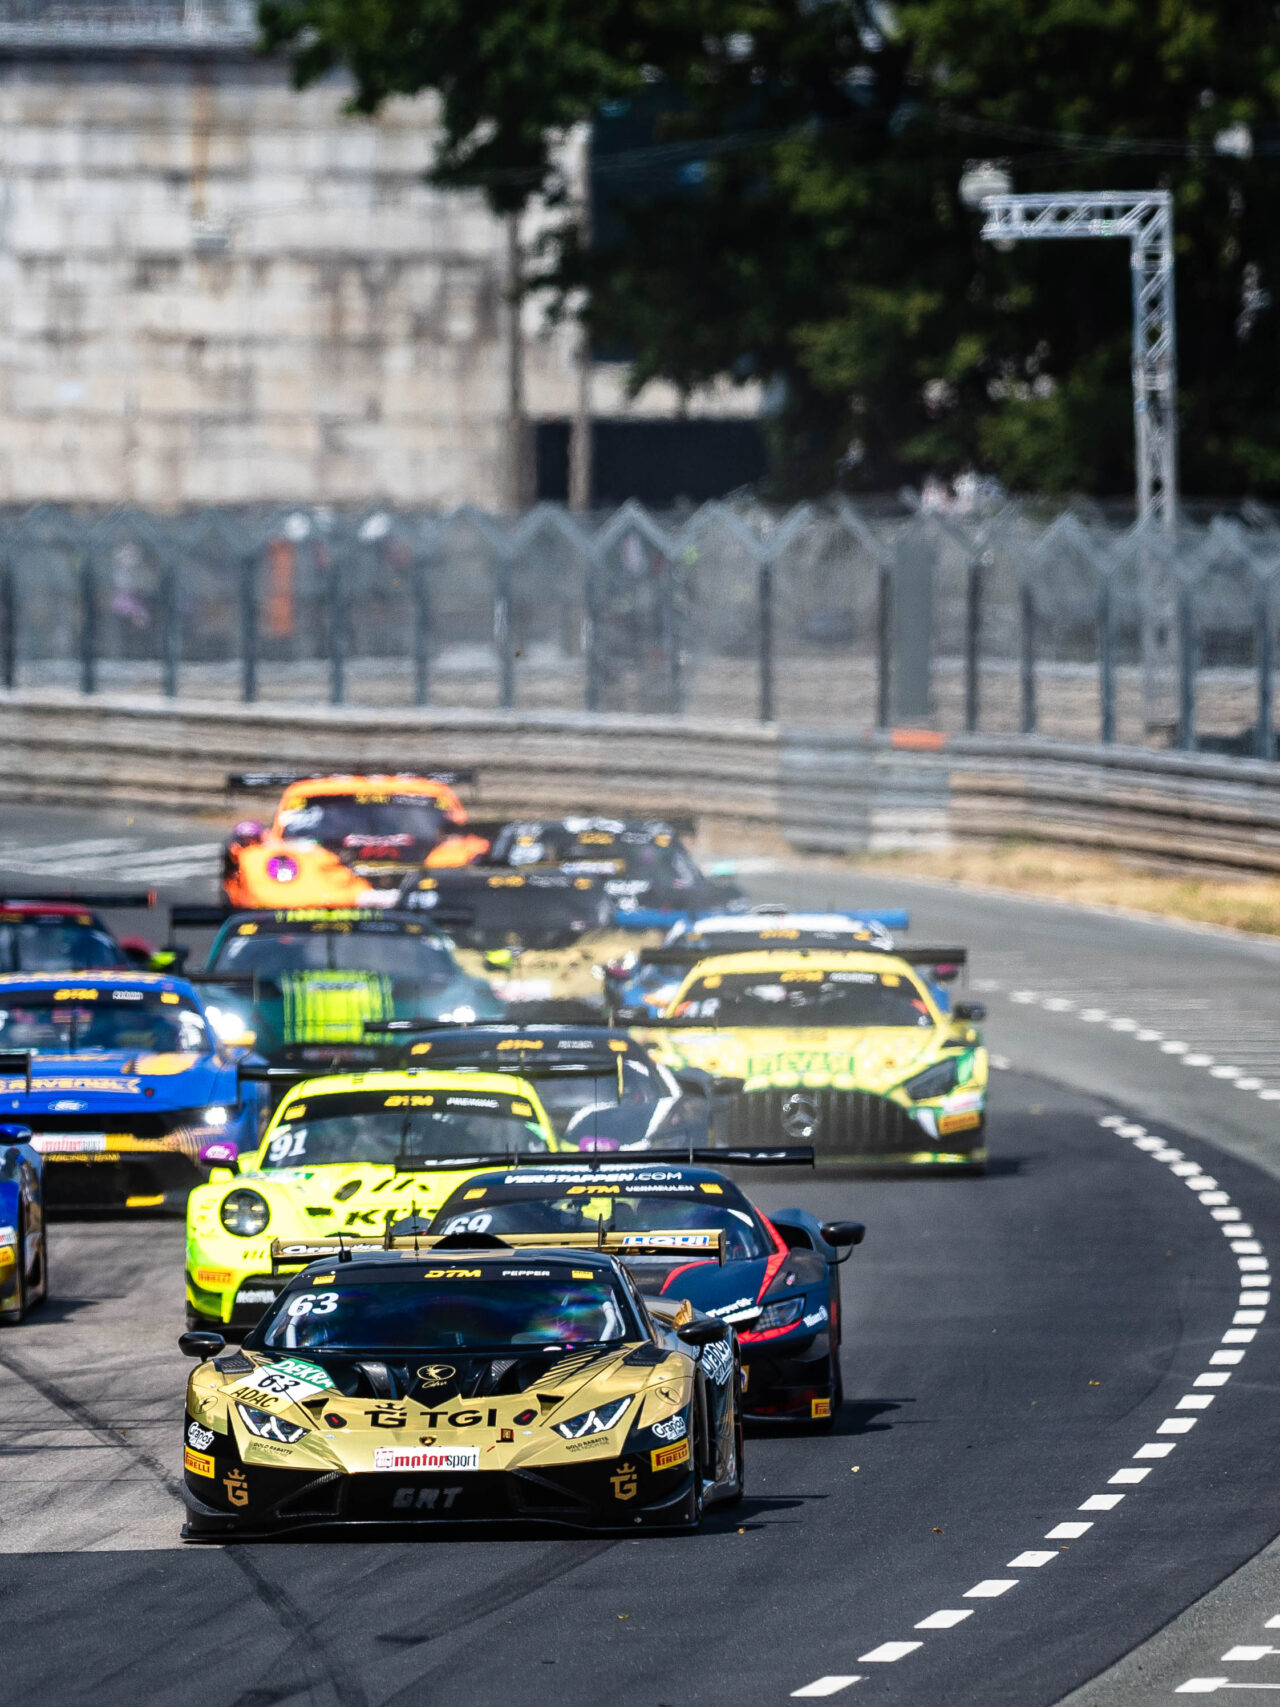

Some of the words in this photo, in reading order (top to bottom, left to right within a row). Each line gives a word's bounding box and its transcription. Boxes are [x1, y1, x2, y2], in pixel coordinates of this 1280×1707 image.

[269, 1128, 308, 1162] 91
[504, 1172, 683, 1185] VERSTAPPEN.COM
[566, 1185, 621, 1195] DTM
[443, 1213, 493, 1236] 69
[424, 1268, 482, 1279] DTM
[502, 1270, 551, 1278] PEPPER
[287, 1291, 340, 1317] 63
[257, 1374, 301, 1394] 63
[230, 1386, 279, 1408] ADAC
[420, 1408, 497, 1428] TGI
[651, 1414, 687, 1439] Grapos
[188, 1421, 215, 1445] Grapos
[394, 1453, 477, 1468] motorsport
[655, 1443, 688, 1467] PIRELLI
[392, 1486, 464, 1509] GRT
